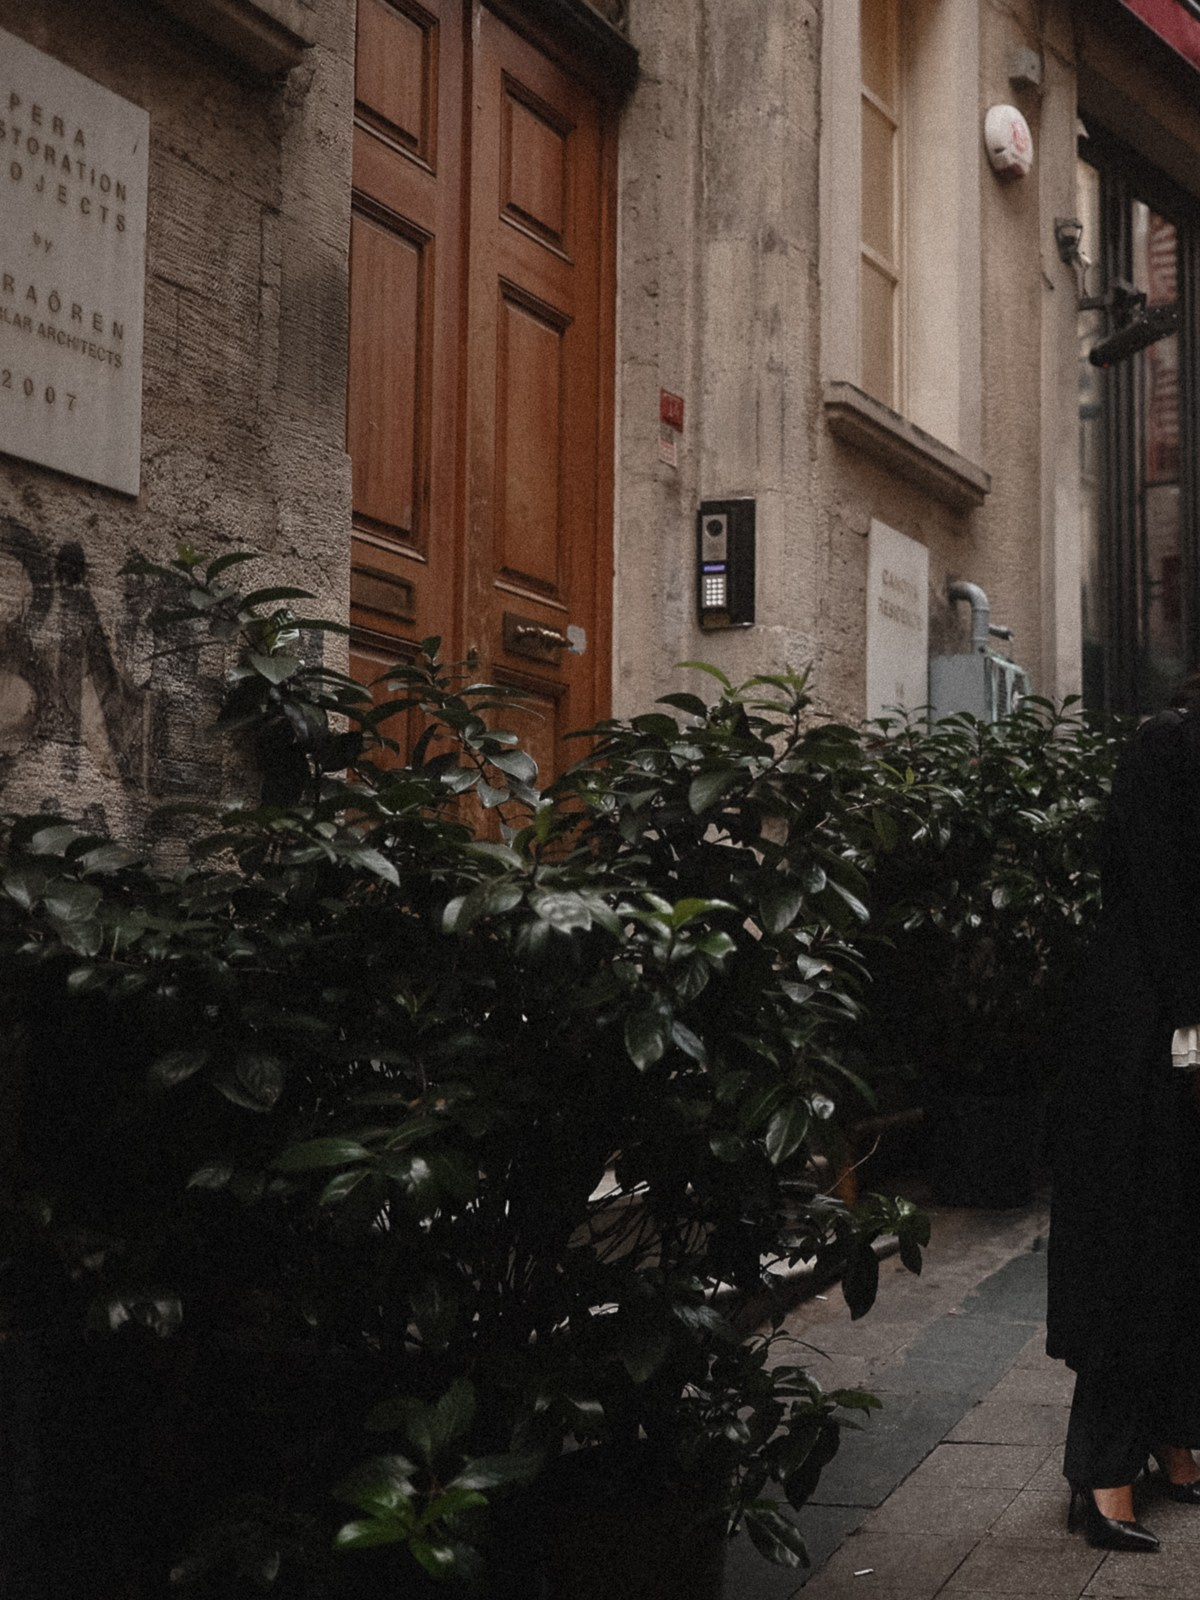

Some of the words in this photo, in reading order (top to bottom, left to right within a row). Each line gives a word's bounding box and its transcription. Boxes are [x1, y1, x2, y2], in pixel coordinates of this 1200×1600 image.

[9, 92, 85, 148] PERA
[33, 231, 52, 253] by
[2, 369, 76, 411] 2007
